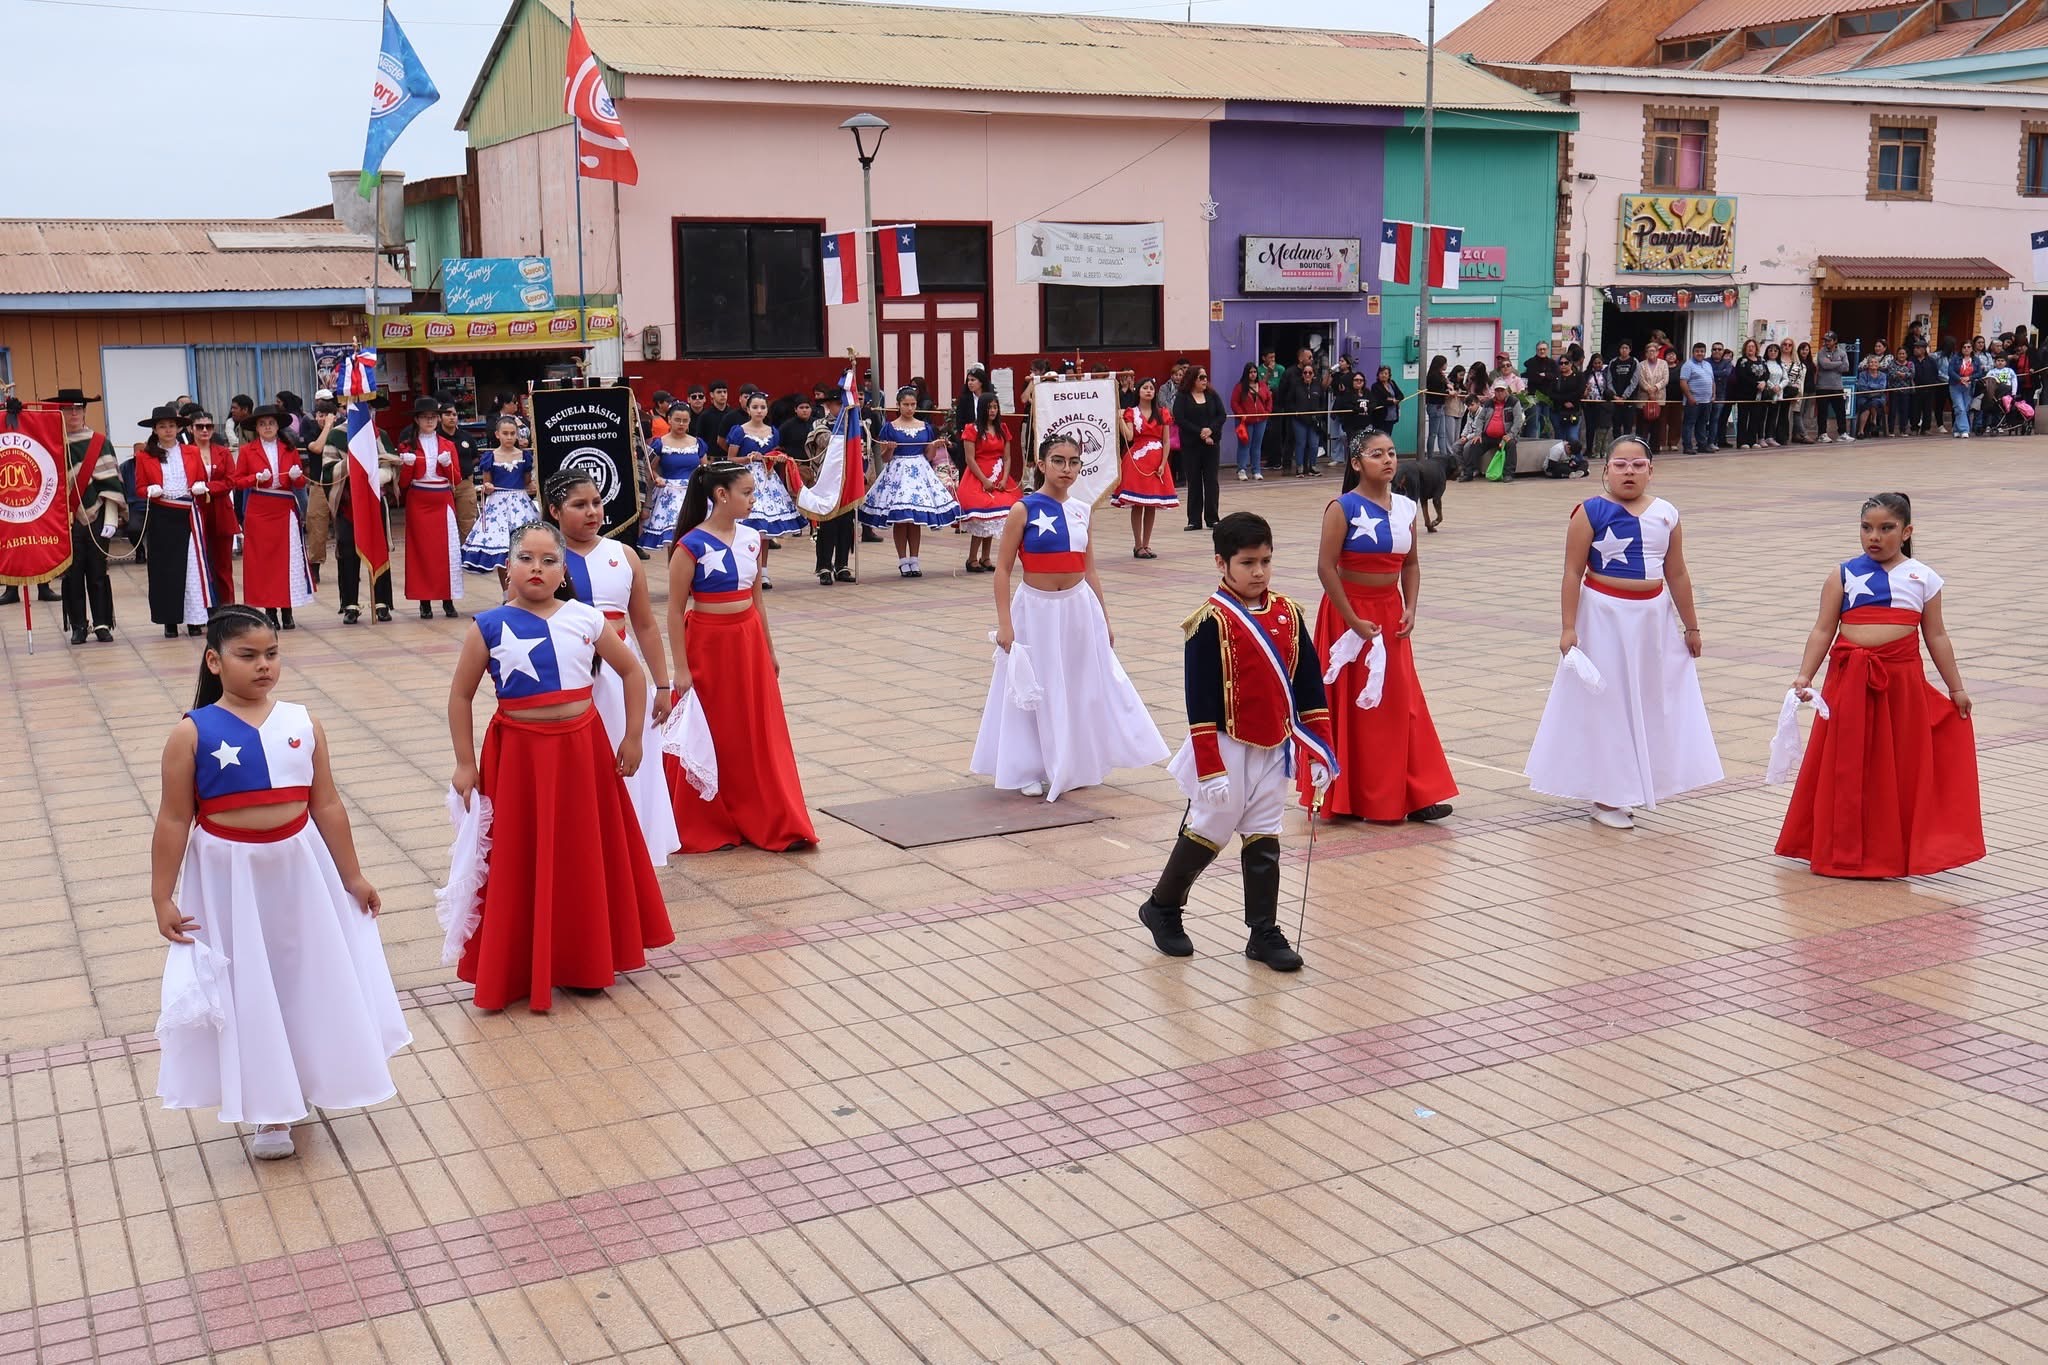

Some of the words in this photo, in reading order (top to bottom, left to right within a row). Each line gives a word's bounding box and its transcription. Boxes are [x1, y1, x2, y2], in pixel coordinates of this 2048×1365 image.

[374, 81, 399, 108] ory
[1632, 216, 1726, 253] Panguipulli
[1258, 242, 1333, 269] Medano's
[1462, 249, 1487, 259] zar
[1053, 391, 1099, 401] ESCUELA
[544, 405, 586, 429] ESCUELA
[588, 404, 621, 425] BÁSICA
[1087, 414, 1111, 434] G-107
[559, 422, 608, 432] VICTORIANO
[0, 435, 32, 449] CEO
[551, 433, 596, 443] QUINTEROS
[597, 432, 618, 440] SOTO
